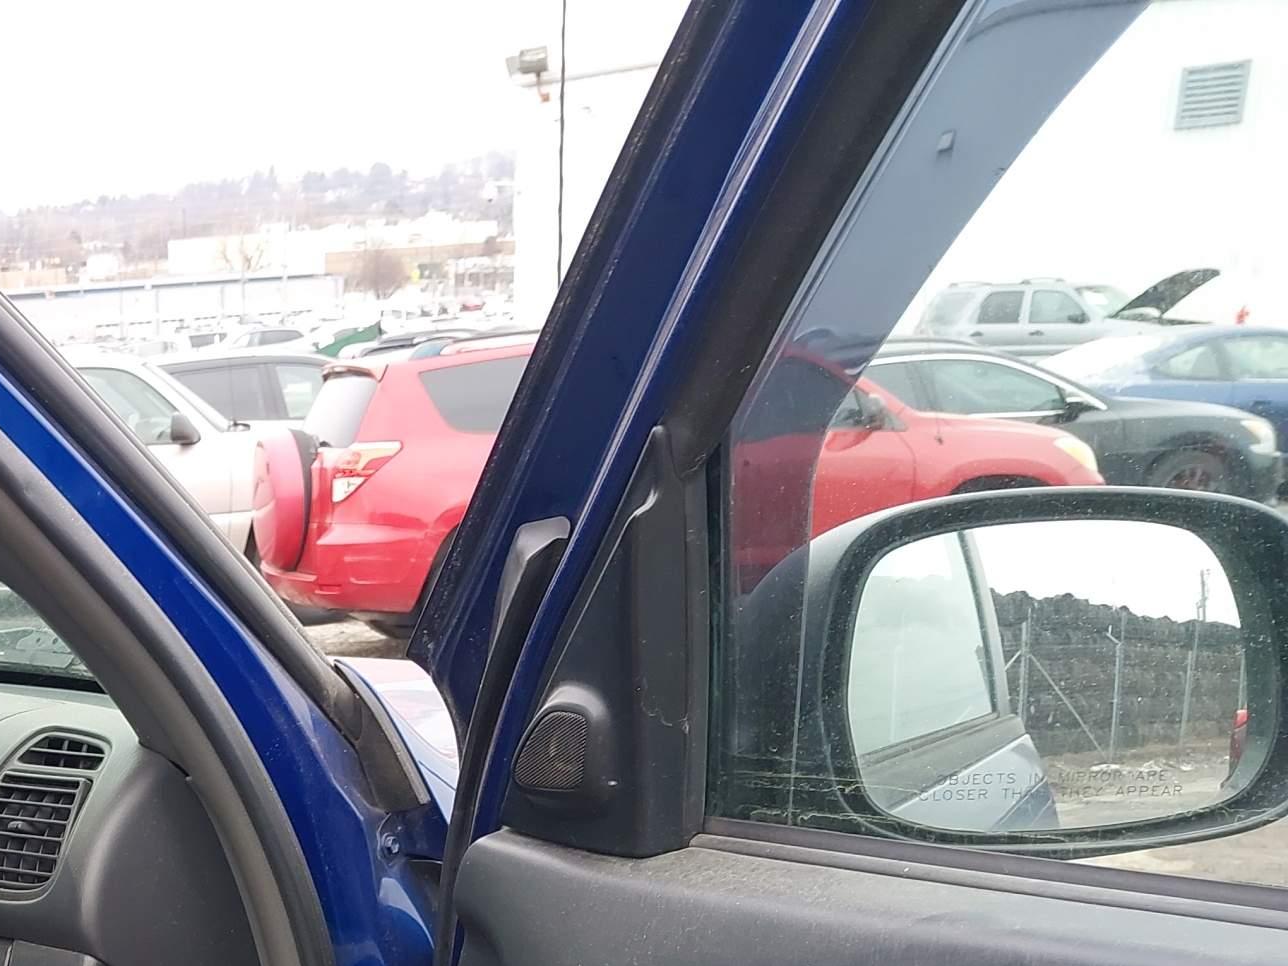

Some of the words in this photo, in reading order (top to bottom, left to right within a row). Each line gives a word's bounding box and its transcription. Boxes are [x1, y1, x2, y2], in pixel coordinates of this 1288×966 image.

[937, 772, 1017, 786] OBJECTS
[1058, 770, 1123, 783] MIRROR
[1135, 769, 1169, 781] ARE
[919, 788, 989, 802] CLOSER
[1059, 785, 1105, 798] THEY
[1114, 784, 1183, 797] APPEAR
